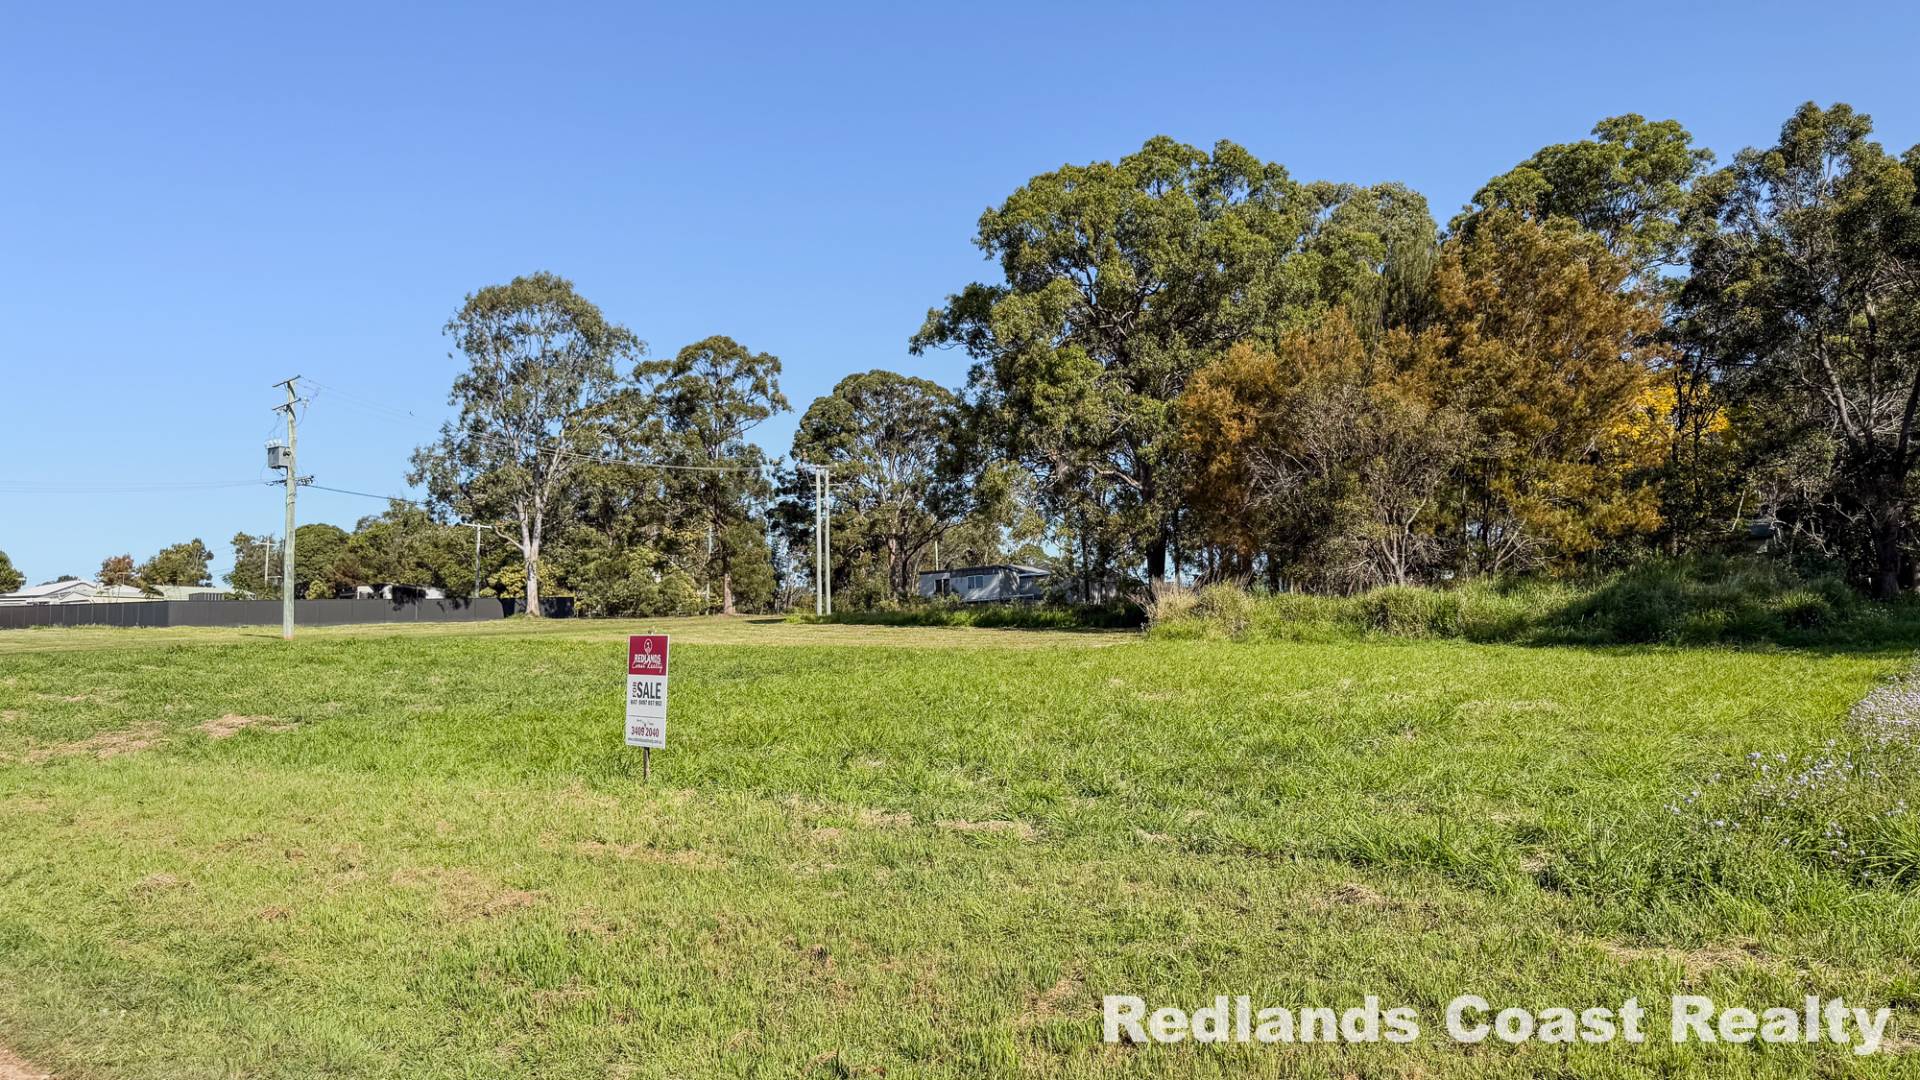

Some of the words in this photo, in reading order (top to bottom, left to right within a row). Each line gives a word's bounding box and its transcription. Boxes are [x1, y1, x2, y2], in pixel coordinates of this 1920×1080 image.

[634, 654, 662, 663] REDLANDS
[637, 681, 662, 699] SALE
[631, 726, 645, 736] 3409
[645, 727, 660, 737] 2040
